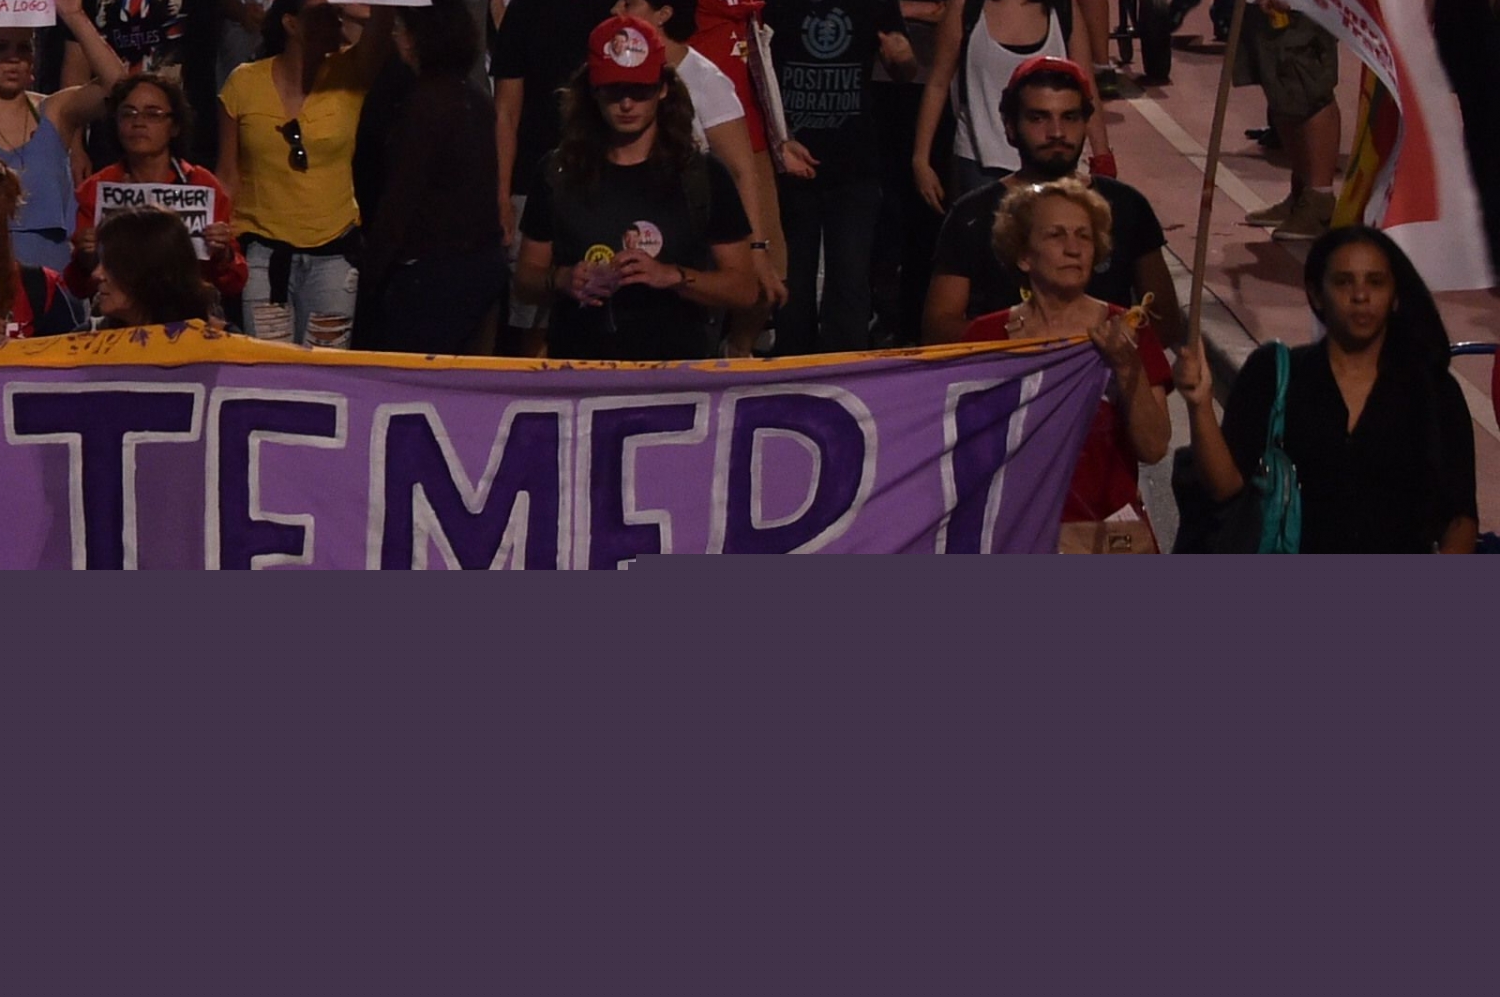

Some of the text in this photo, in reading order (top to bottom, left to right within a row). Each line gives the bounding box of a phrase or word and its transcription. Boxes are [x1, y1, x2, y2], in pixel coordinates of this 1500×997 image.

[782, 66, 862, 90] POSITIVE
[782, 89, 861, 111] VIBRATION
[103, 187, 209, 208] FORA TEMER!
